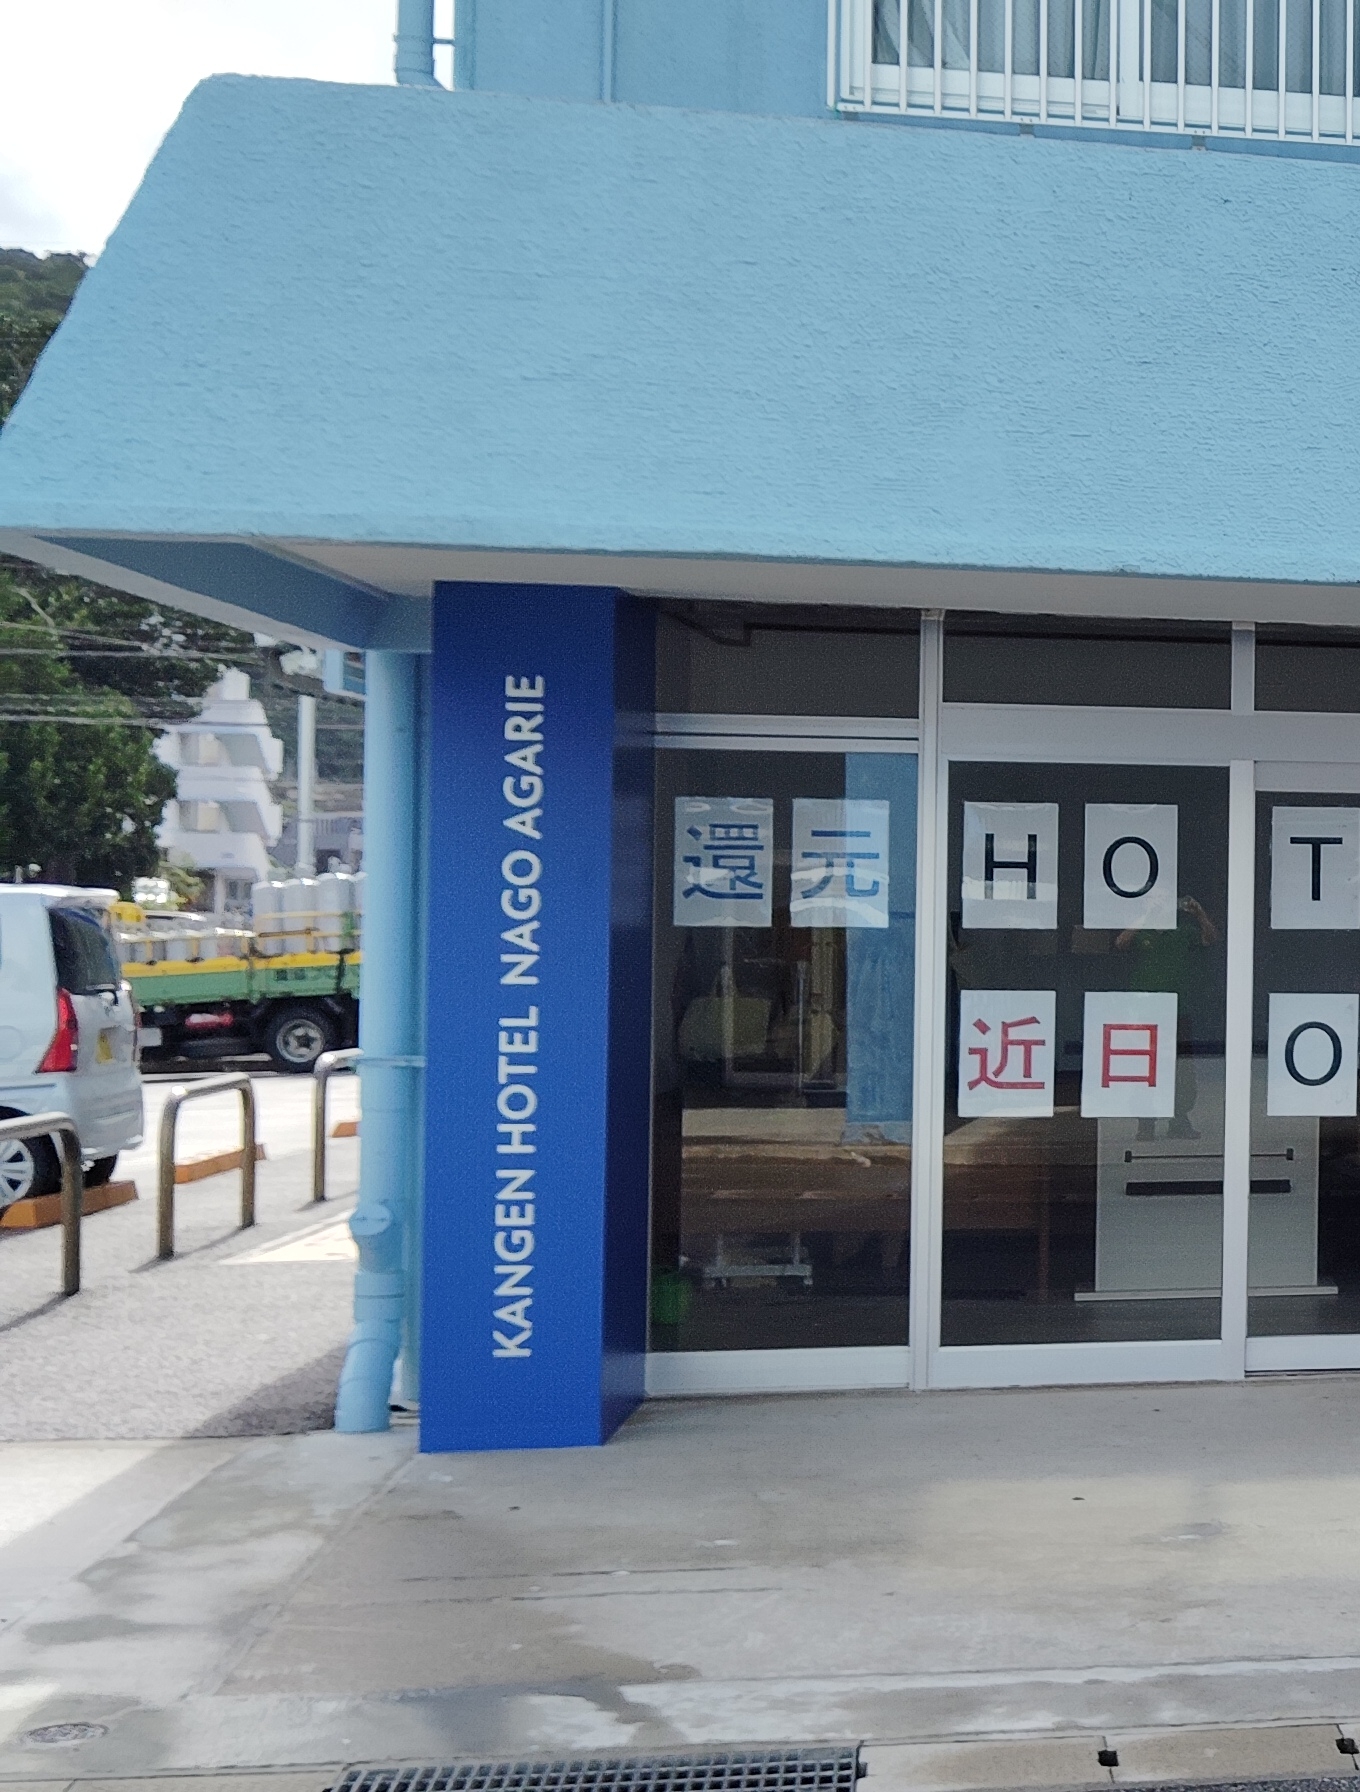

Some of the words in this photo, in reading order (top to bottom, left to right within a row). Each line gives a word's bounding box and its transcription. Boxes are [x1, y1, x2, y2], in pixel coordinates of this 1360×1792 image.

[502, 674, 545, 840] AGARIE
[500, 849, 543, 986] NAGO
[496, 1005, 539, 1155] HOTEL
[967, 1015, 1159, 1091] 近日
[492, 1167, 536, 1358] KANGEN
